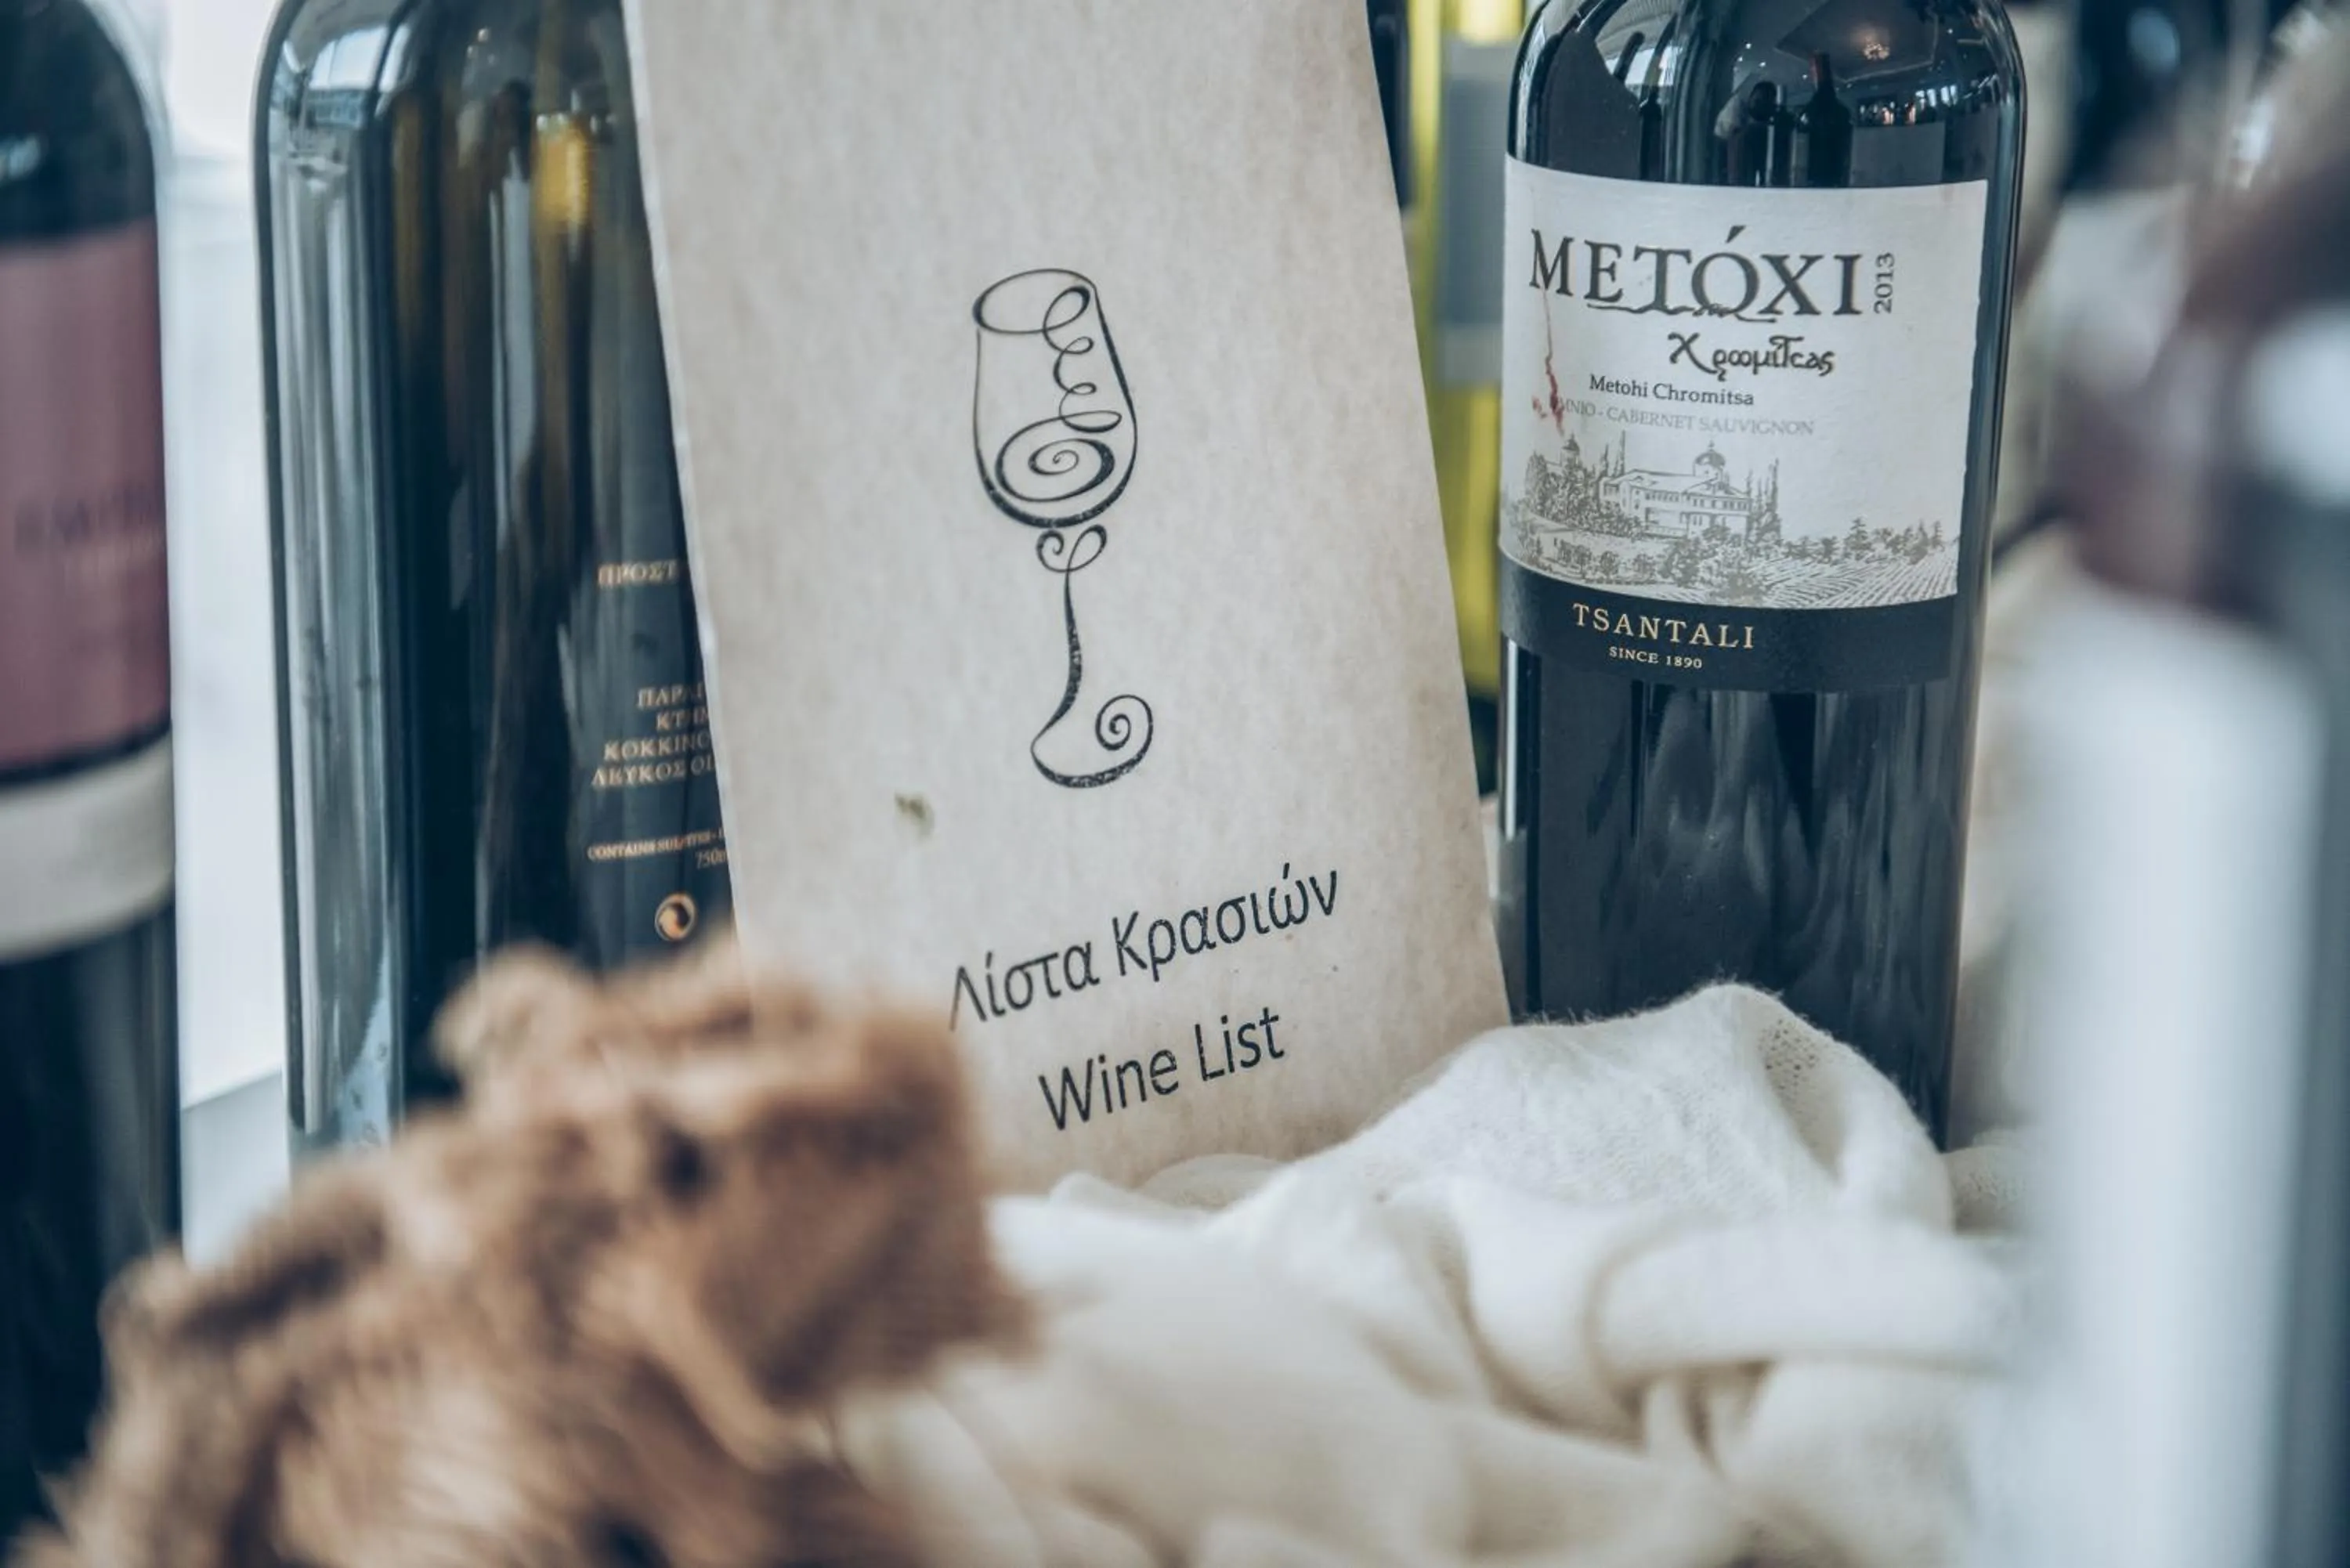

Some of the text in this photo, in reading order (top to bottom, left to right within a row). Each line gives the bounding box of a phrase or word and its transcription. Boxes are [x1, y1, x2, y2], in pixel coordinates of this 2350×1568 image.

[1873, 252, 1895, 314] 2013
[1589, 373, 1755, 406] Metohi Chromitsa
[1606, 406, 1696, 431] CABERNET
[1699, 416, 1815, 435] SAUVIGNON
[1572, 602, 1755, 649] TSANTALI
[1608, 646, 1703, 669] SINCE 1890
[949, 862, 1338, 1032] Λίστα Κρασιών
[1038, 1006, 1285, 1131] Wine List
